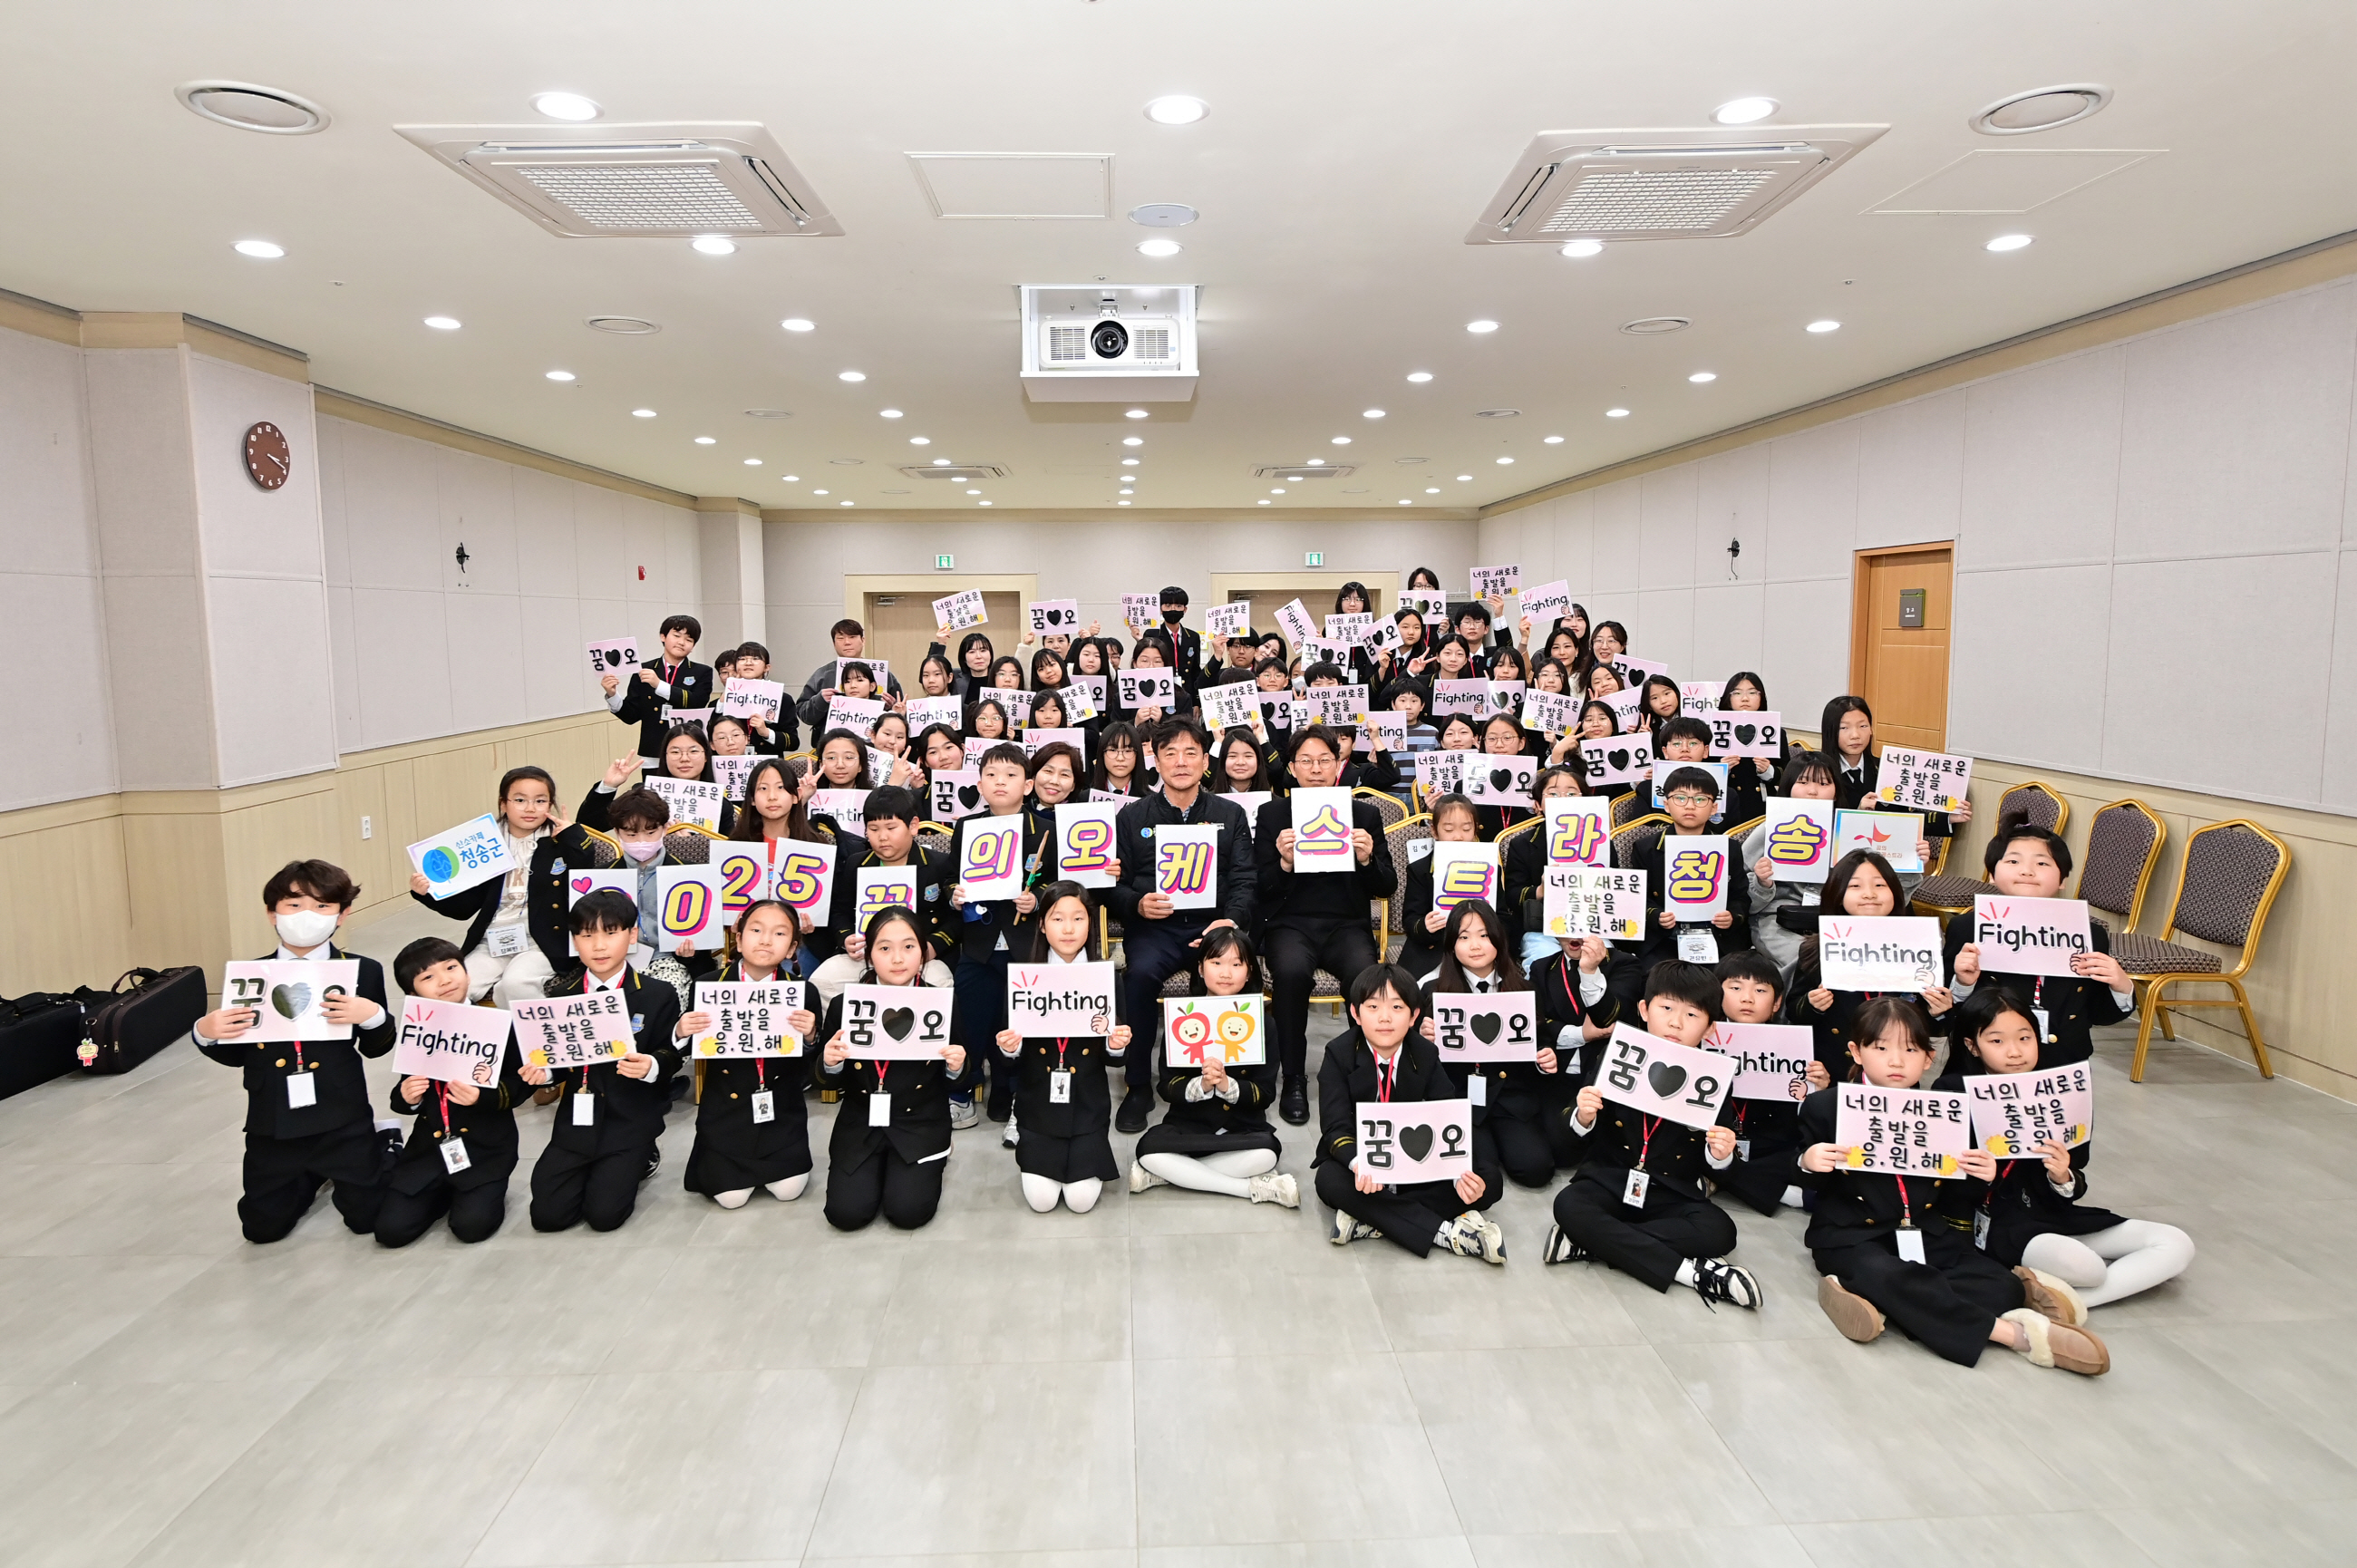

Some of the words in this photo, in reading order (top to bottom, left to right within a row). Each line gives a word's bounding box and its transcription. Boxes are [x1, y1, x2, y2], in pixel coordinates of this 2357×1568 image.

[1473, 570, 1489, 578] 너의
[1495, 566, 1519, 576] 새로운
[1483, 576, 1507, 589] 출발을
[936, 600, 952, 611] 너의
[956, 591, 979, 605] 새로운
[1136, 595, 1158, 607] 새로운
[1208, 609, 1221, 618] 너의
[1224, 604, 1246, 615] 새로운
[1432, 601, 1443, 615] 오
[1522, 595, 1569, 615] Fighting
[1031, 608, 1045, 631] 꿈
[1064, 608, 1077, 625] 오
[1285, 605, 1306, 640] Fightin
[1328, 617, 1343, 625] 너의
[1348, 615, 1371, 624] 새로운
[1363, 635, 1377, 658] 꿈
[1386, 624, 1398, 641] 오
[589, 648, 606, 672] 꿈
[625, 648, 638, 664] 오
[1336, 651, 1346, 666] 오
[1007, 693, 1033, 706] 새로운
[1092, 686, 1104, 702] 오
[1120, 677, 1137, 702] 꿈
[1159, 679, 1173, 697] 오
[1204, 691, 1223, 701] 너의
[1228, 684, 1255, 697] 새로운
[1311, 691, 1330, 700] 너의
[1337, 687, 1365, 699] 새로운
[1435, 692, 1484, 706] Fighting
[1217, 697, 1244, 714] 출발을
[1278, 702, 1291, 719] 오
[1322, 699, 1350, 713] 출발을
[1529, 693, 1548, 704] 너의
[1553, 698, 1578, 712] 새로운
[1537, 703, 1564, 721] 출발을
[1683, 697, 1720, 712] Fight
[1355, 726, 1403, 740] Figting
[1712, 721, 1731, 749] 꿈
[1760, 725, 1778, 746] 오
[716, 760, 737, 769] 너의
[1419, 756, 1438, 765] 너의
[1445, 754, 1464, 764] 새로
[1586, 749, 1605, 778] 꿈
[1634, 748, 1652, 769] 오
[1887, 753, 1916, 767] 너의
[1924, 758, 1966, 777] 새로운
[728, 771, 748, 785] 출발
[1431, 765, 1460, 781] 출발을
[1515, 771, 1532, 792] 오
[1900, 768, 1941, 790] 출발을
[683, 785, 719, 801] 새로운
[935, 781, 955, 815] 꿈
[456, 831, 485, 849] 산소카페
[1295, 804, 1350, 855] 스
[1549, 812, 1606, 862] 라
[1767, 814, 1828, 866] 송
[460, 837, 504, 869] 청송군
[962, 828, 1019, 883] 의
[1060, 819, 1113, 872] 오
[1158, 841, 1214, 894] 케
[1669, 850, 1725, 904] 청
[722, 855, 761, 911] 2
[776, 853, 828, 908] 5
[1435, 860, 1495, 910] 트
[1550, 874, 1584, 890] 너의
[1594, 874, 1641, 894] 새로운
[662, 880, 713, 936] 0
[1567, 891, 1616, 915] 출발을
[1979, 923, 2087, 953] Fighting
[1825, 942, 1934, 970] Fighting
[518, 1006, 555, 1021] 너의
[566, 995, 620, 1018] 새로운
[702, 989, 736, 1005] 너의
[748, 987, 798, 1007] 새로운
[1012, 990, 1109, 1017] Fighting
[541, 1019, 596, 1044] 출발을
[721, 1008, 771, 1031] 출발을
[849, 1000, 878, 1047] 꿈
[919, 1010, 945, 1040] 오
[1437, 1008, 1466, 1050] 꿈
[1507, 1013, 1532, 1043] 오
[401, 1024, 498, 1065] Fighting
[1608, 1040, 1648, 1091] 꿈
[1685, 1075, 1720, 1108] 오
[1974, 1082, 2020, 1101] 너의
[2034, 1070, 2086, 1098] 새로운
[1846, 1094, 1888, 1113] 너의
[1902, 1099, 1962, 1123] 새로운
[2004, 1099, 2066, 1128] 출발을
[1868, 1116, 1928, 1147] 출발을
[1362, 1119, 1394, 1169] 꿈
[1440, 1124, 1467, 1158] 오
